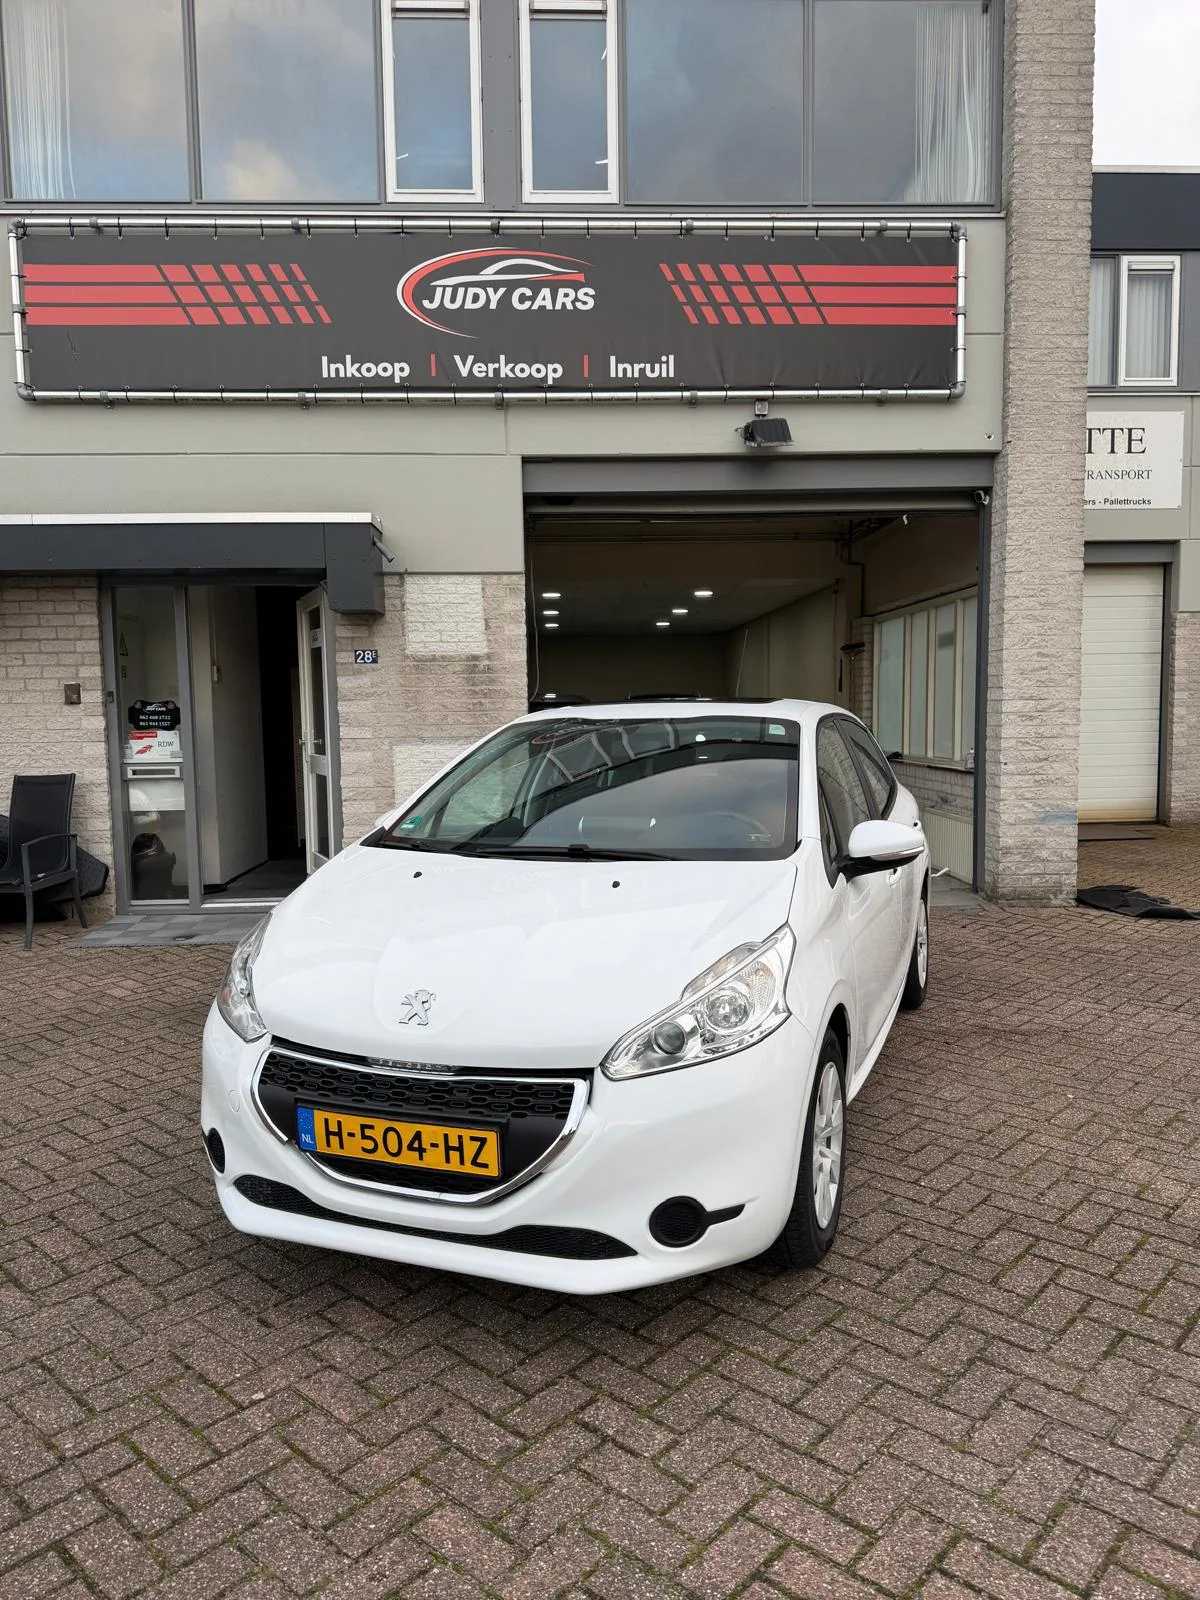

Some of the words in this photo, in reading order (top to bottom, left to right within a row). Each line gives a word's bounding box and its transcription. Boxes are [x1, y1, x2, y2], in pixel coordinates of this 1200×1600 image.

[422, 287, 507, 310] JUDY
[511, 287, 596, 311] CARS
[321, 355, 410, 384] Inkoop
[453, 355, 564, 385] Verkoop
[609, 355, 675, 378] Inruil
[1103, 497, 1152, 506] Pallettrucks
[301, 1133, 314, 1144] NL
[323, 1117, 490, 1169] H-504-HZ
